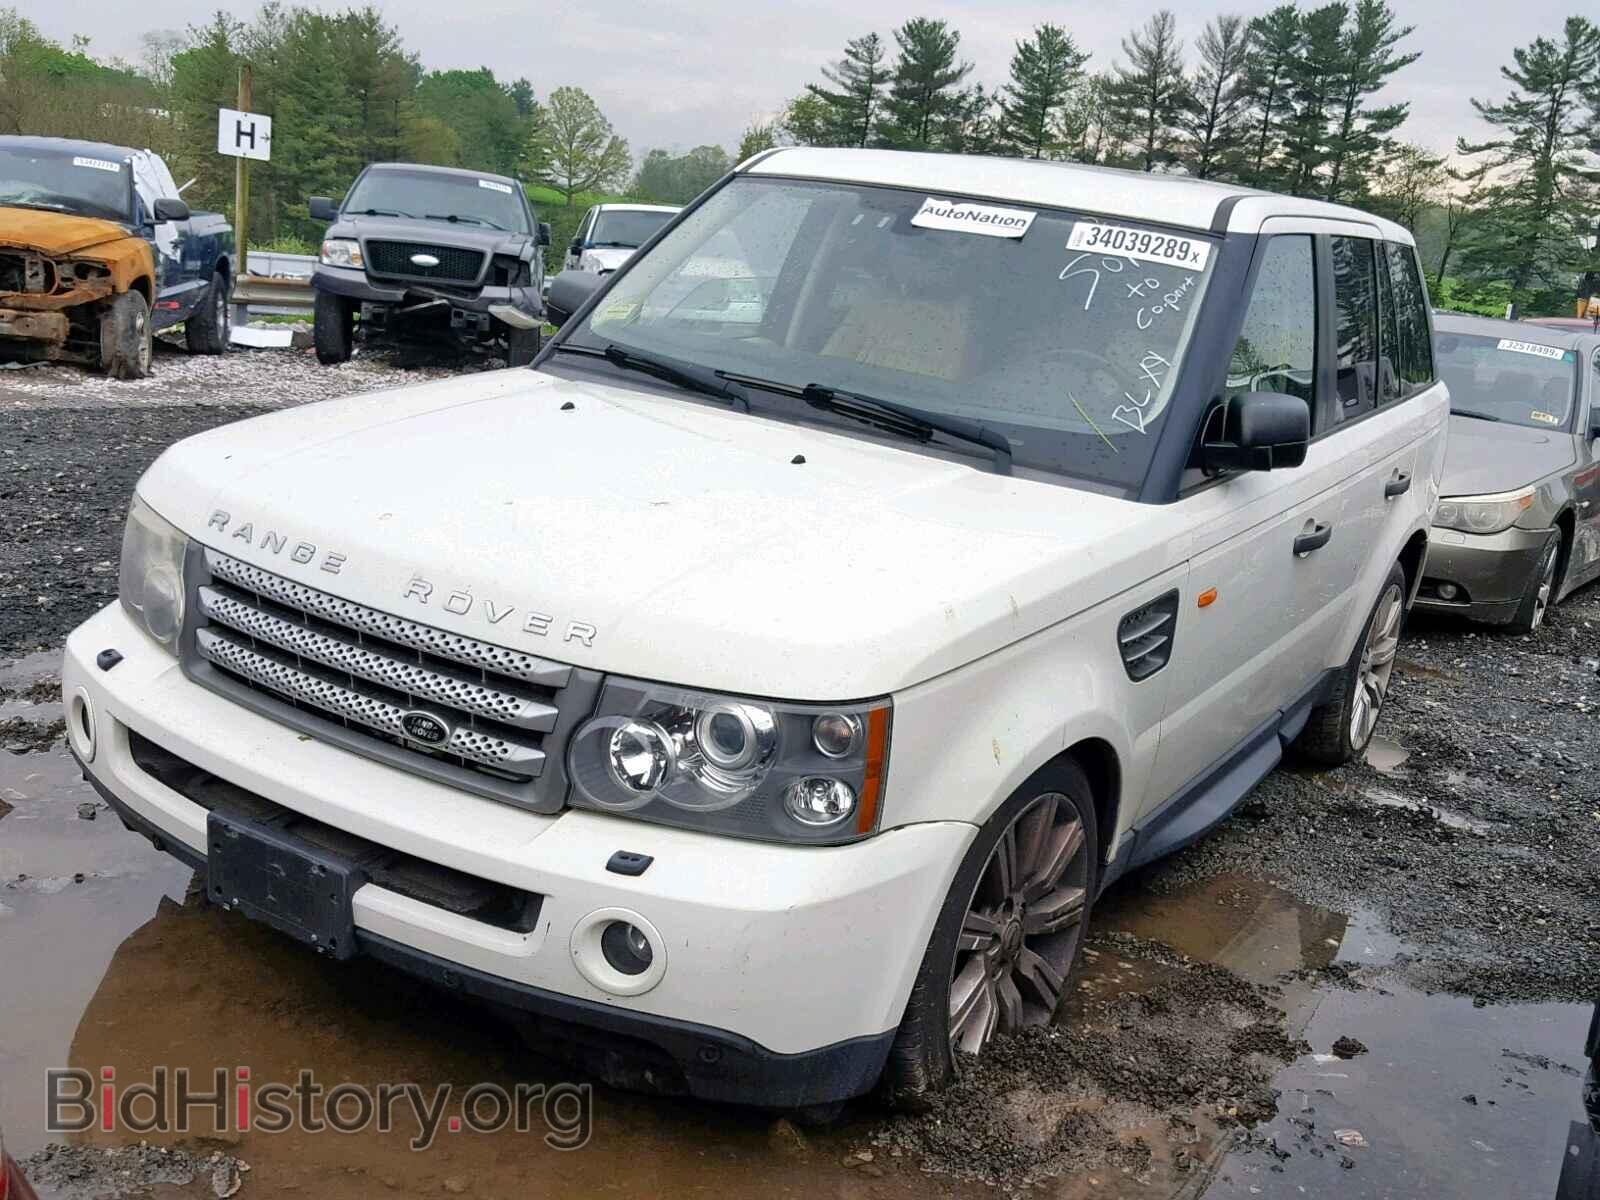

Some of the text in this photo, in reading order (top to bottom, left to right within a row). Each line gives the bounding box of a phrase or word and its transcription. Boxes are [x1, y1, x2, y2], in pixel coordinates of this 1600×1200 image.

[236, 120, 255, 149] H
[921, 206, 1027, 228] AutoNation
[208, 509, 597, 647] RANGE ROVER
